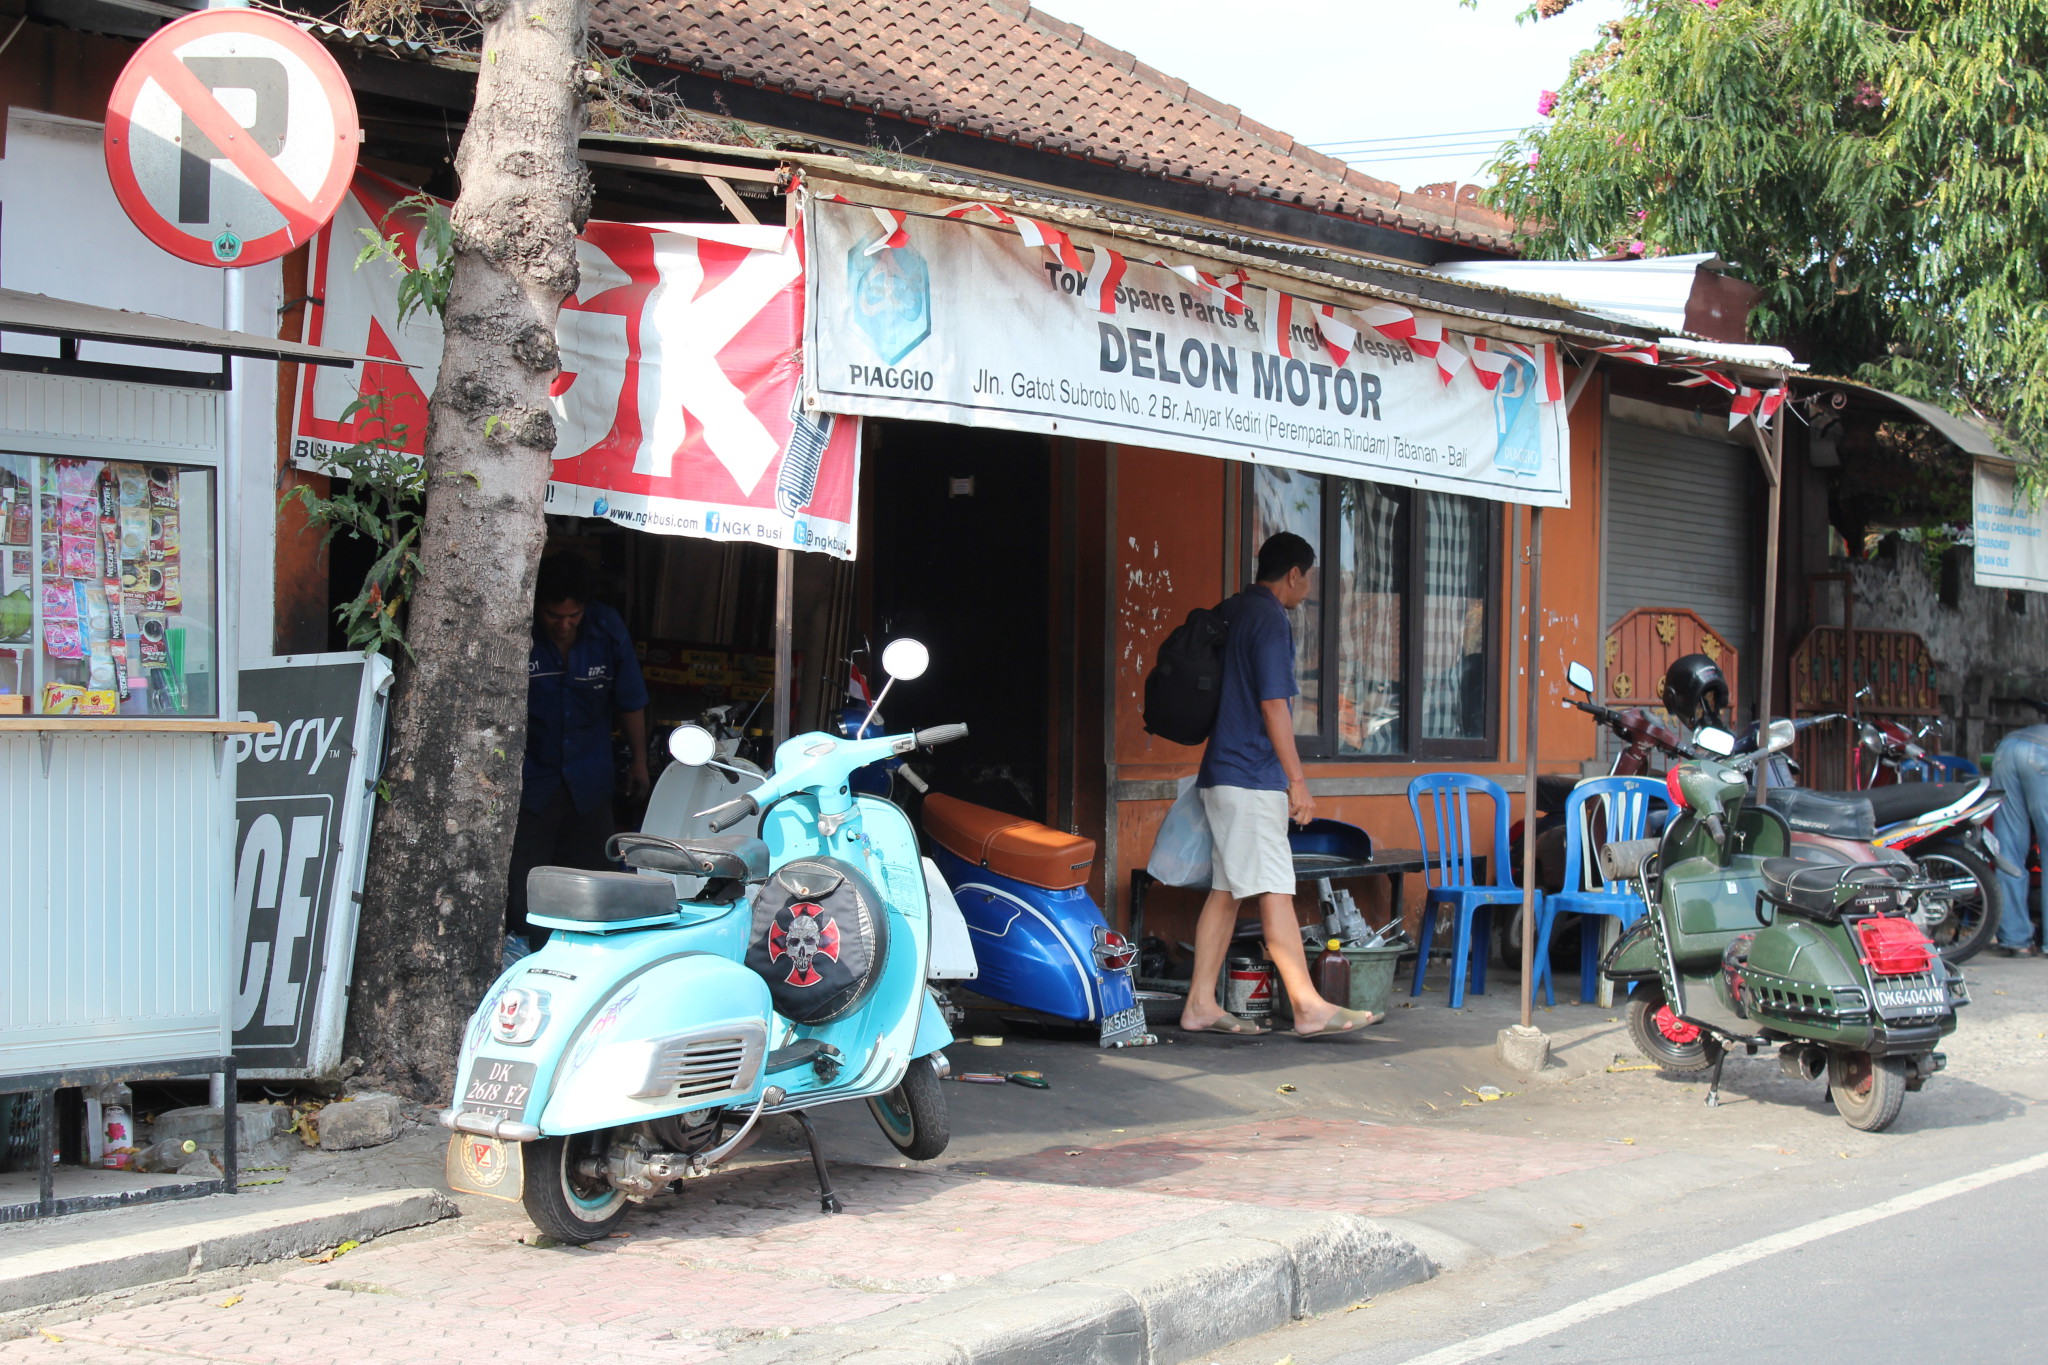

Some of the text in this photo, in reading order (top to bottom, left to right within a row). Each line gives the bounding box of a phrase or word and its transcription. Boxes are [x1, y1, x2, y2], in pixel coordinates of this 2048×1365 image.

[179, 56, 289, 224] P
[1045, 262, 1089, 297] Tok
[1115, 282, 1176, 315] Spare
[1179, 292, 1238, 328] Parts
[1244, 308, 1260, 333] &
[1354, 332, 1415, 366] Vespa
[849, 364, 934, 391] PIAGGIO
[973, 369, 1004, 396] Jln.
[1011, 372, 1055, 402] Gatot
[1059, 379, 1117, 411] Subroto
[1119, 389, 1144, 416] No.
[1148, 394, 1157, 417] 2
[1161, 396, 1180, 421] Br.
[1183, 400, 1222, 432] Anyar
[1225, 407, 1262, 434] Kediri
[1265, 413, 1340, 449] (Perempatan
[1343, 427, 1391, 461] Rindam)
[1393, 436, 1439, 464] Tabanan
[1448, 445, 1468, 468] Bali
[1098, 321, 1382, 421] DELON MOTOR
[609, 507, 699, 530] www.ngkbusi.com
[722, 521, 752, 537] NGK
[756, 522, 783, 540] Busi
[234, 812, 324, 1033] CE
[466, 1080, 529, 1107] 2618 EZ
[488, 1062, 514, 1082] DK
